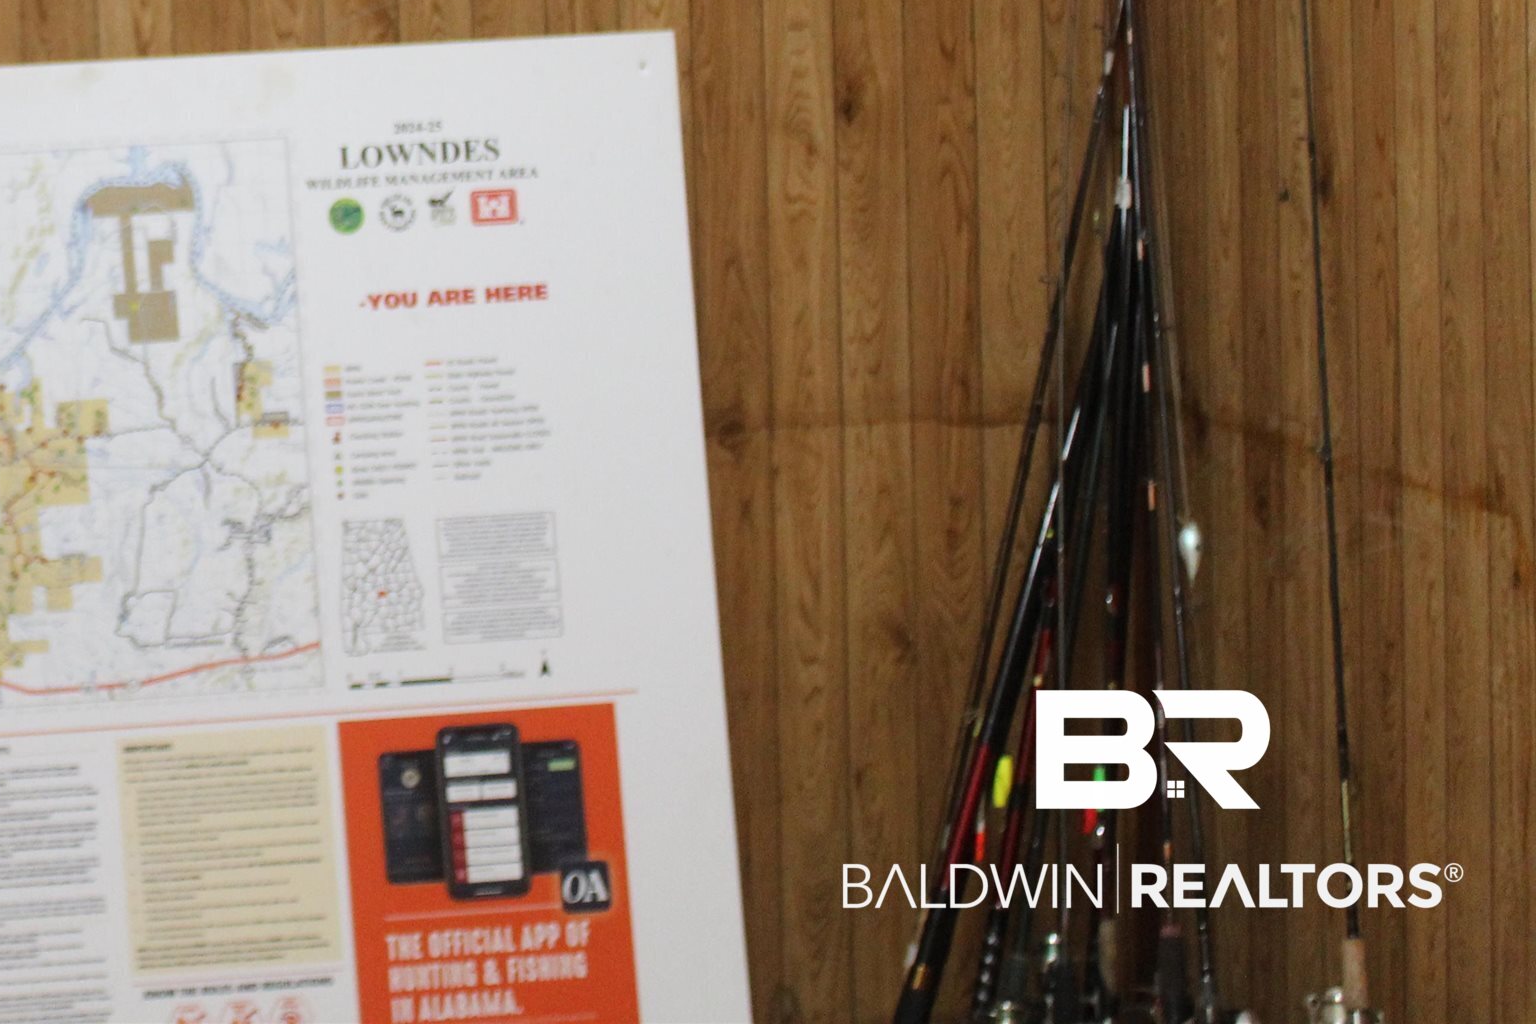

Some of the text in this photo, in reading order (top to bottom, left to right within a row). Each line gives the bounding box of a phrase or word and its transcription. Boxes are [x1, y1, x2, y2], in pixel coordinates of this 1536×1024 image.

[393, 121, 443, 134] 2024-25
[339, 138, 501, 170] LOWNDES
[306, 166, 539, 191] WILDLIFE MANAGEMENT AREA
[367, 282, 549, 310] YOU ARE HERE
[563, 868, 609, 904] OA
[385, 920, 590, 961] THE OFFICIAL APP OF
[388, 951, 588, 992] HUNTING & FISHING
[390, 997, 414, 1024] IN
